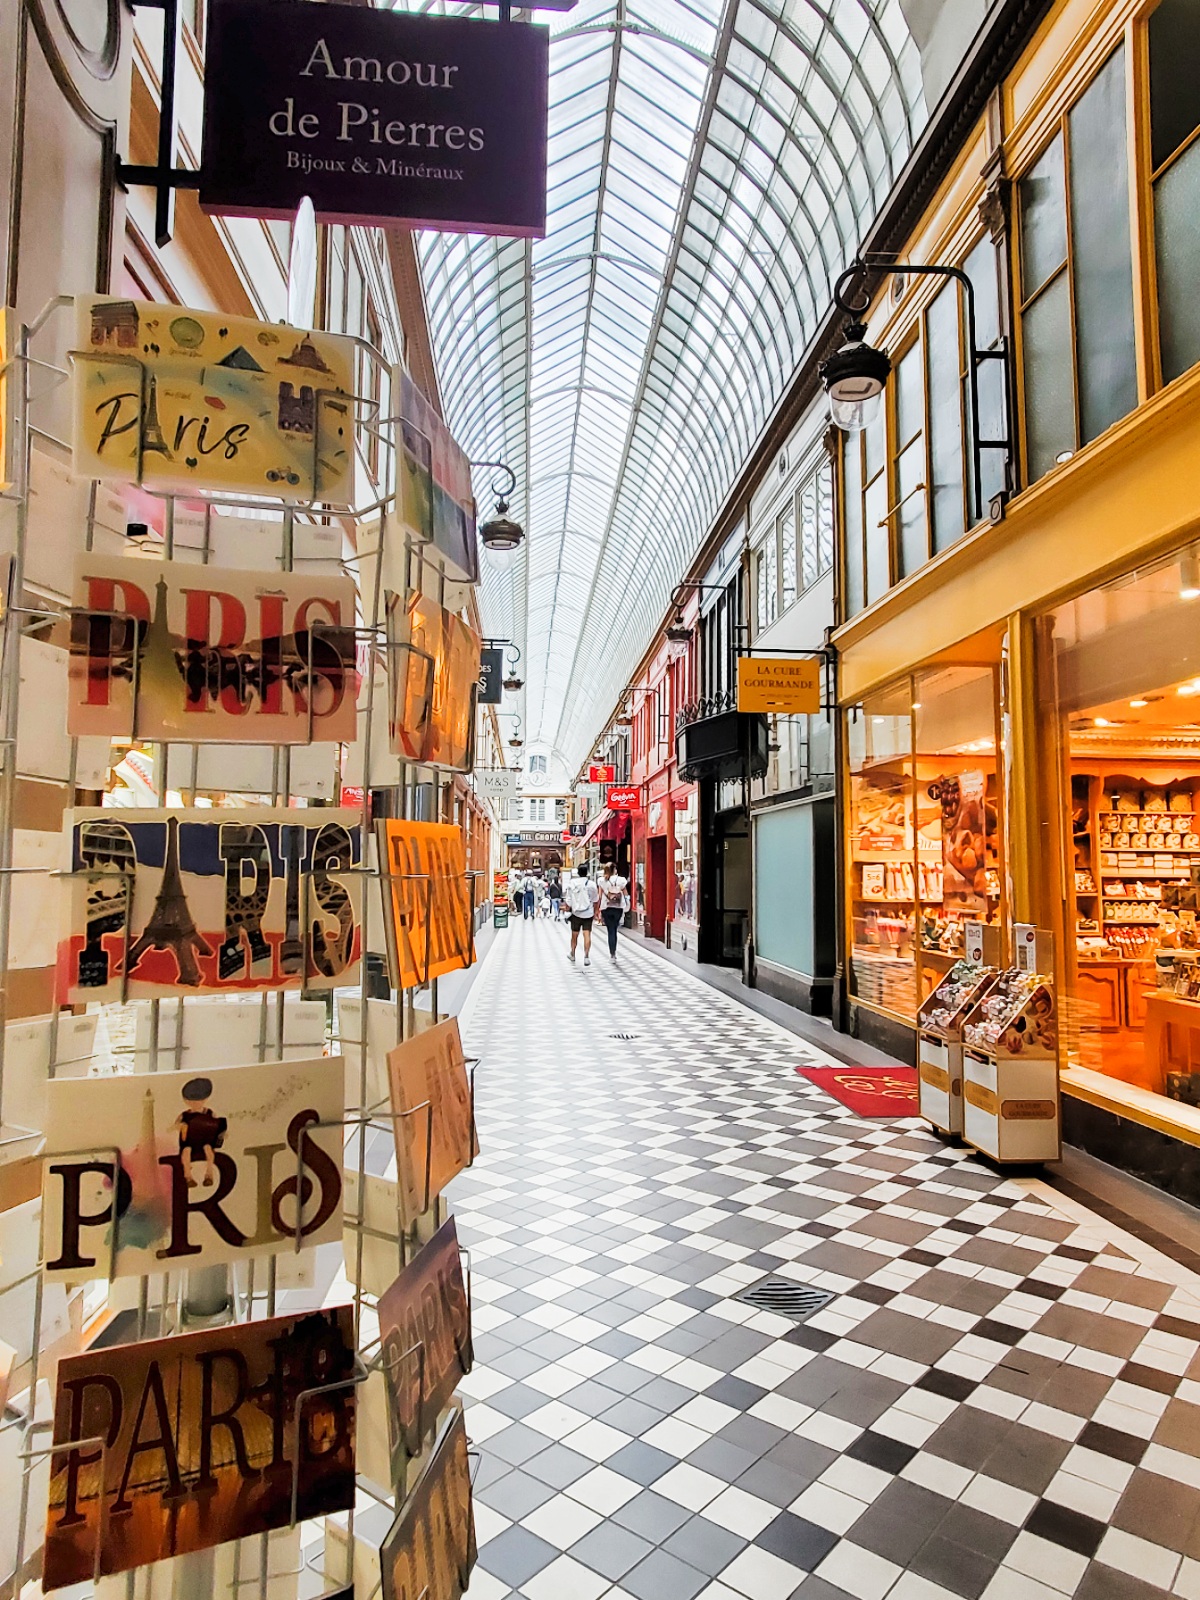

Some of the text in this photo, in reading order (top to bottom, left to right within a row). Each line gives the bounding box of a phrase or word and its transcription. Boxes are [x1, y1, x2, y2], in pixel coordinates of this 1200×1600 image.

[299, 37, 459, 89] Amour
[268, 97, 485, 151] de Pierres
[286, 151, 464, 181] Bijoux & Minéraux
[757, 666, 802, 676] LA CURE
[744, 678, 814, 689] GOURMANDE
[484, 776, 509, 788] M&S
